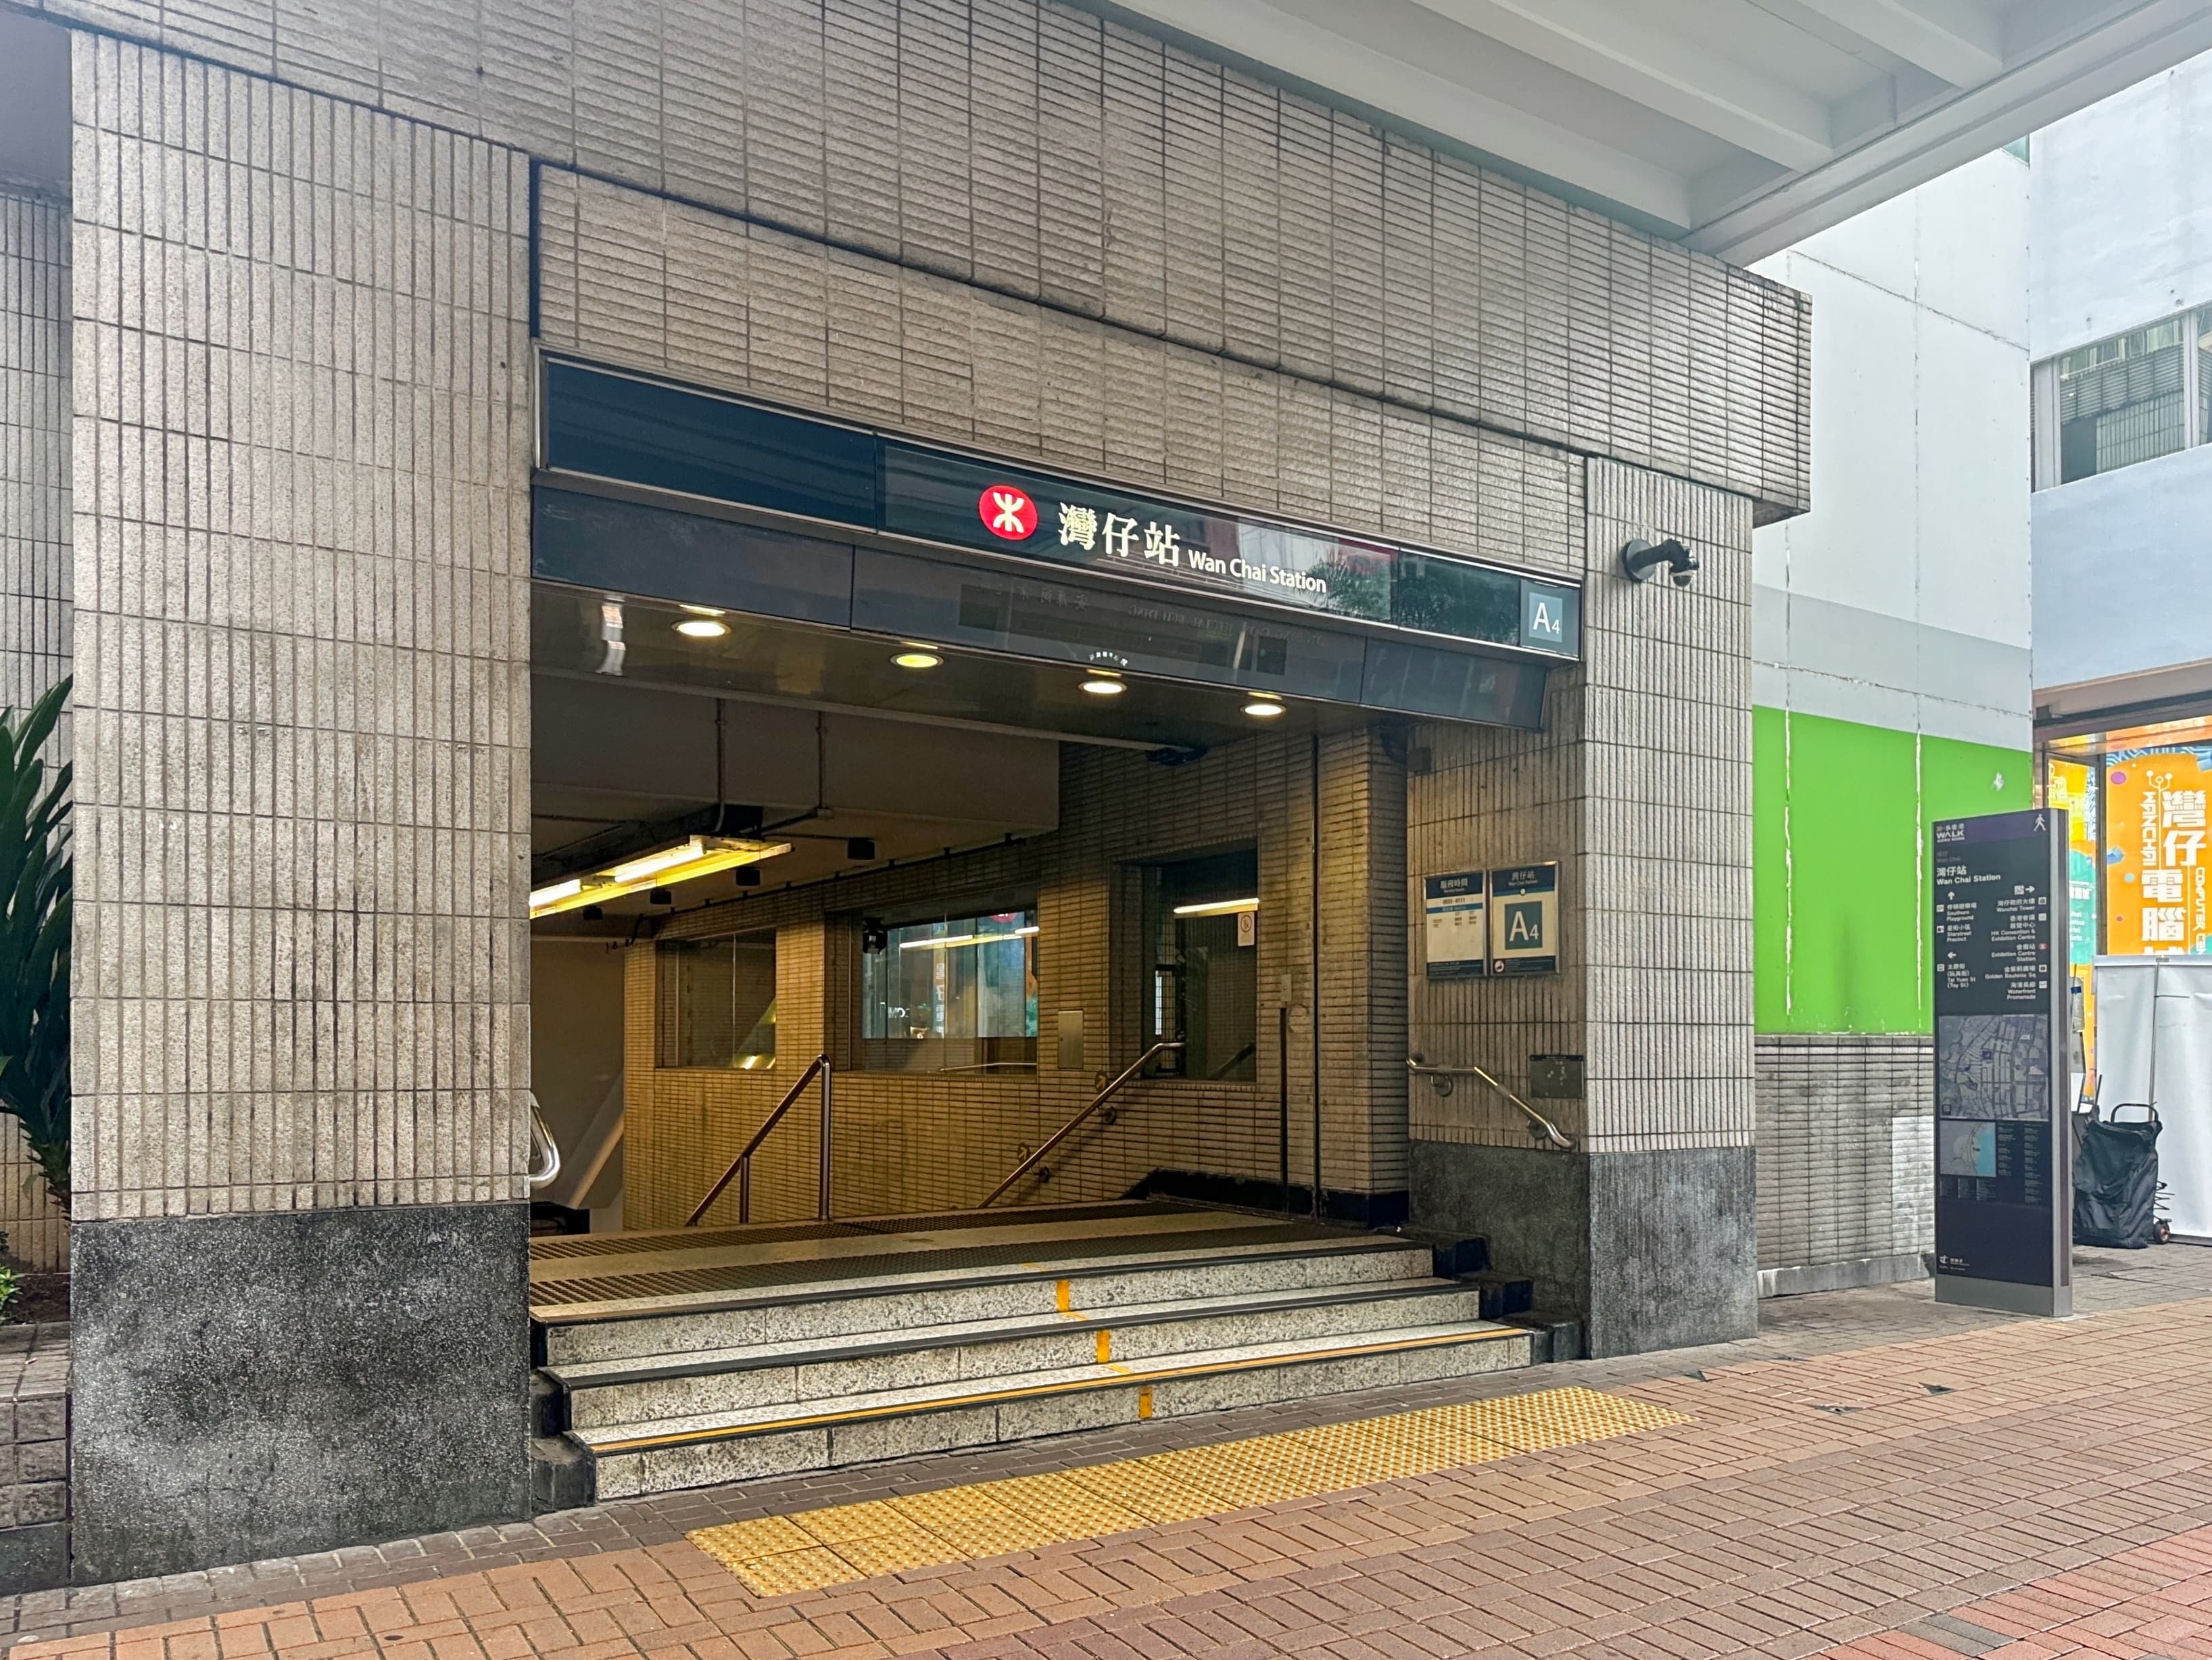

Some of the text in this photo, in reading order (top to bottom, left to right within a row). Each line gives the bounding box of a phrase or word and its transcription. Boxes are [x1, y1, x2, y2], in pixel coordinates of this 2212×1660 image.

[1058, 502, 1181, 567] 灣仔站
[1188, 549, 1326, 593] Wan Chai Station
[1936, 865, 1967, 877] 灣仔站
[1973, 874, 2001, 882] Station
[2192, 866, 2206, 930] COMPUTER
